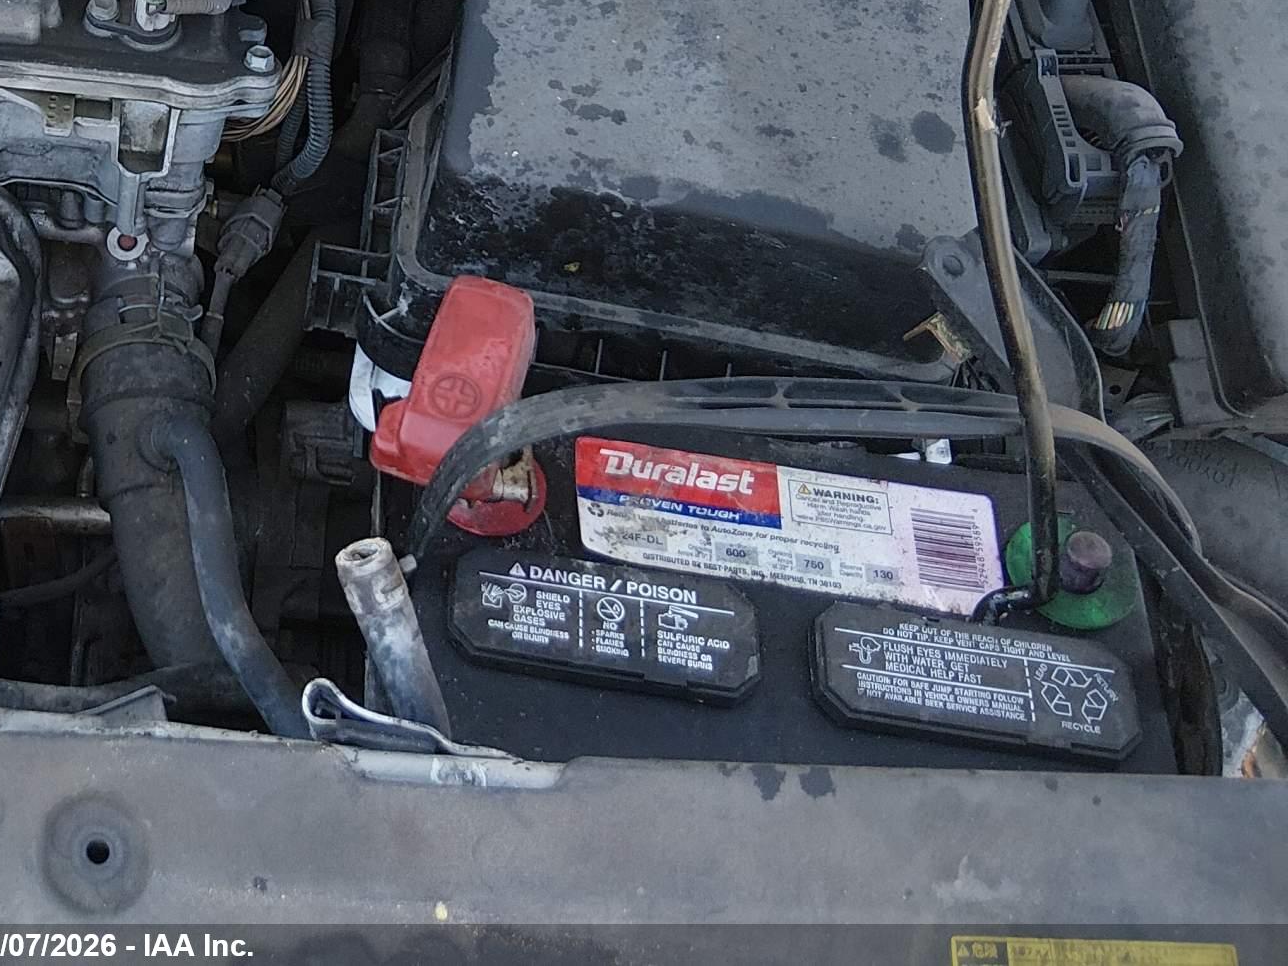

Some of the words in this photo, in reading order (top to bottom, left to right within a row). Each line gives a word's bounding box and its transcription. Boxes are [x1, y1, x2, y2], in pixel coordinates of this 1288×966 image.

[600, 448, 755, 495] Duralast
[813, 488, 879, 504] WARNING:
[619, 494, 683, 512] PROVEN
[688, 506, 740, 521] TOUGH
[711, 525, 753, 539] AutoZone
[769, 534, 798, 547] proper
[799, 538, 840, 553] recycling
[622, 532, 662, 546] 24F-DL
[725, 548, 746, 559] 600
[803, 559, 825, 571] 750
[873, 569, 894, 581] 130
[529, 566, 605, 590] DANGER
[627, 581, 696, 604] POISON
[536, 591, 570, 603] SHIELD
[536, 600, 561, 611] EYES
[513, 605, 565, 621] EXPLOSIVE
[513, 614, 545, 627] GASES
[488, 619, 504, 629] CAN
[504, 621, 528, 632] CAUSE
[529, 626, 570, 639] BLINDNESS
[596, 629, 624, 640] SPARKS
[603, 621, 618, 631] NO
[596, 637, 624, 648] FLAMES
[657, 630, 705, 646] SULFURIC
[707, 639, 730, 650] ACID
[657, 640, 673, 649] CAN
[675, 642, 701, 653] CAUSE
[883, 627, 895, 636] DO
[897, 629, 913, 638] NOT
[934, 634, 954, 645] KEEP
[956, 638, 977, 648] VENT
[979, 642, 1000, 652] CAPS
[1003, 645, 1026, 655] TIGHT
[1029, 648, 1045, 658] AND
[1048, 652, 1071, 662] LEVEL
[899, 623, 919, 633] KEEP
[922, 626, 938, 635] OUT
[941, 628, 952, 636] OF
[954, 630, 970, 640] THE
[971, 633, 997, 644] REACH
[1000, 637, 1012, 646] OF
[1014, 640, 1052, 652] CHILDREN
[596, 645, 629, 657] SMOKING
[658, 647, 698, 660] BLINDNESS
[700, 653, 712, 663] OR
[883, 641, 914, 656] FLUSH
[917, 647, 941, 658] EYES
[945, 651, 1008, 668] IMMEDIATELY
[658, 655, 686, 666] SEVERE
[687, 661, 713, 671] BURNS
[884, 651, 909, 663] WITH
[951, 662, 969, 673] GET
[886, 663, 927, 677] MEDICAL
[930, 669, 955, 681] HELP
[958, 673, 982, 685] FAST
[858, 681, 912, 696] INSTRUCTIONS
[914, 688, 922, 696] IN
[924, 690, 954, 702] VEHICLE
[866, 689, 882, 699] NOT
[884, 692, 923, 706] AVAILABLE
[925, 699, 944, 709] SEEK
[946, 703, 978, 714] SERVICE
[893, 678, 908, 687] FOR
[910, 680, 929, 690] SAFE
[931, 683, 951, 694] JUMP
[954, 687, 991, 700] STARTING
[993, 693, 1024, 705] FOLLOW
[1062, 720, 1101, 734] RECYCLE
